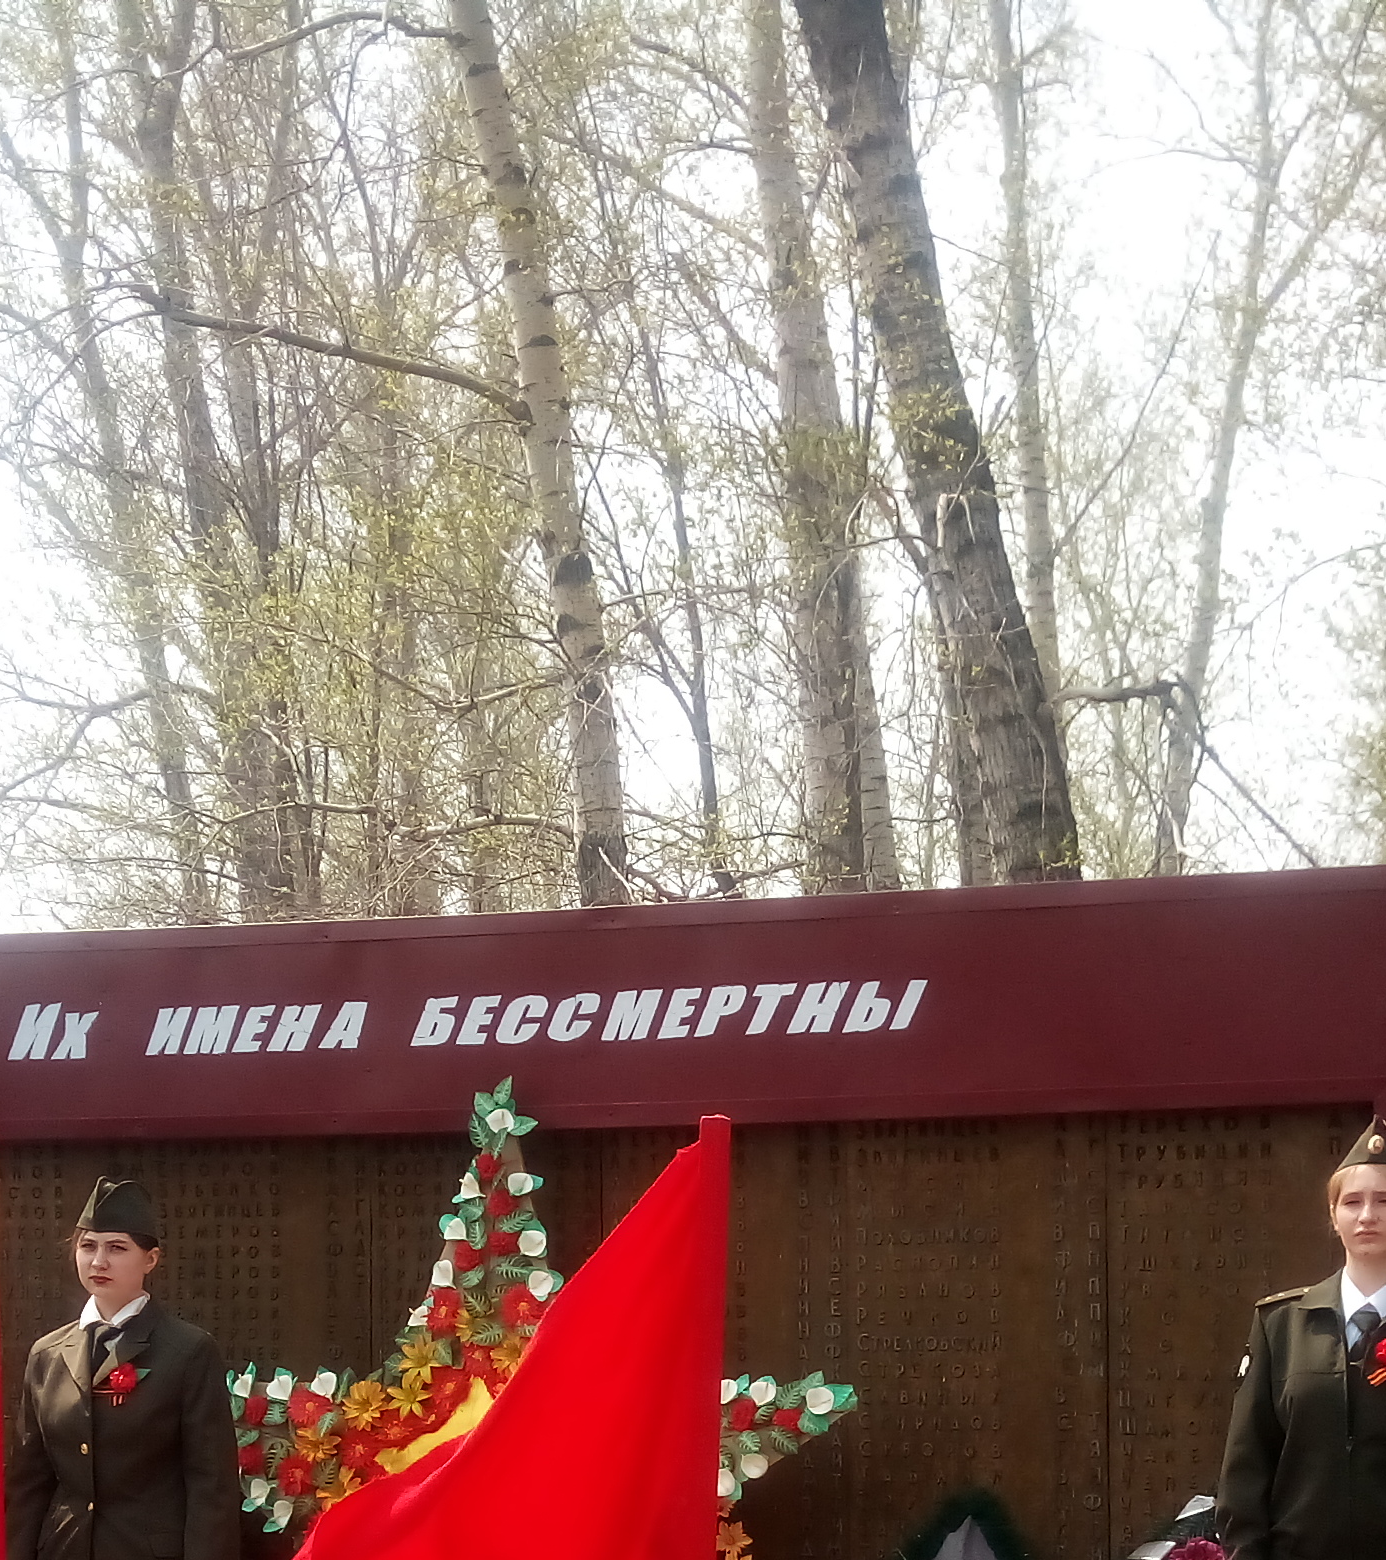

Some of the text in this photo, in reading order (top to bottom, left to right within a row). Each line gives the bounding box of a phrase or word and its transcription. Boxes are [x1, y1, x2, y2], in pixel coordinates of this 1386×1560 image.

[9, 979, 928, 1060] Их ИМЕНА БЕССМЕРТНЫ
